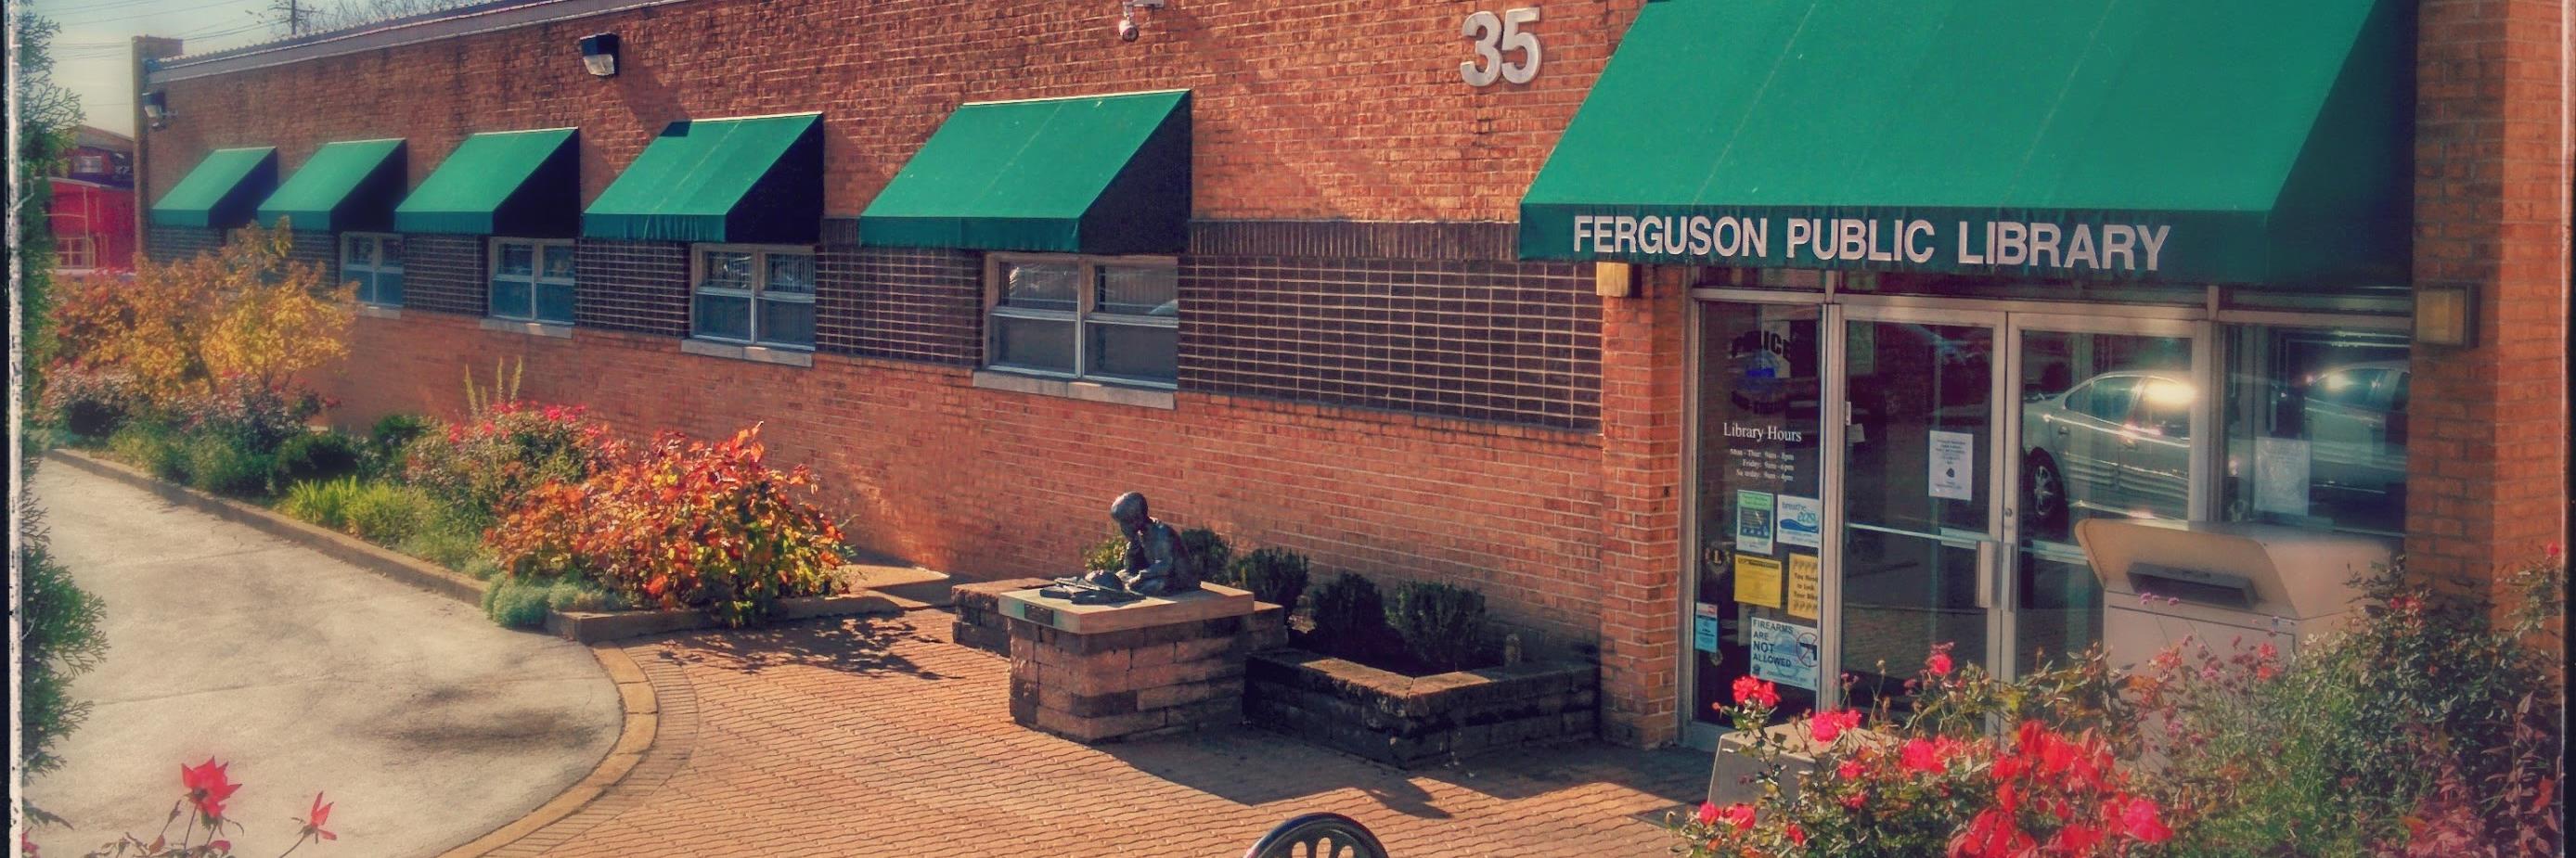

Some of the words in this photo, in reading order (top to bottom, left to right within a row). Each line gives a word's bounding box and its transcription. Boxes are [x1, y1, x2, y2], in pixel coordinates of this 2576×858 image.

[1460, 6, 1541, 87] 35
[1573, 214, 1768, 258] FERGUSON
[1785, 217, 1936, 264] PUBLIC
[1957, 220, 2171, 272] LIBRARY
[1731, 329, 1793, 363] PICE
[1723, 422, 1763, 442] Library
[1768, 426, 1802, 442] Hours
[1735, 468, 1762, 480] Saurday:
[1753, 620, 1794, 634] FIREARMS
[1753, 631, 1769, 640] ARE
[1753, 641, 1774, 653] NOT
[1753, 653, 1792, 668] ALLOWED
